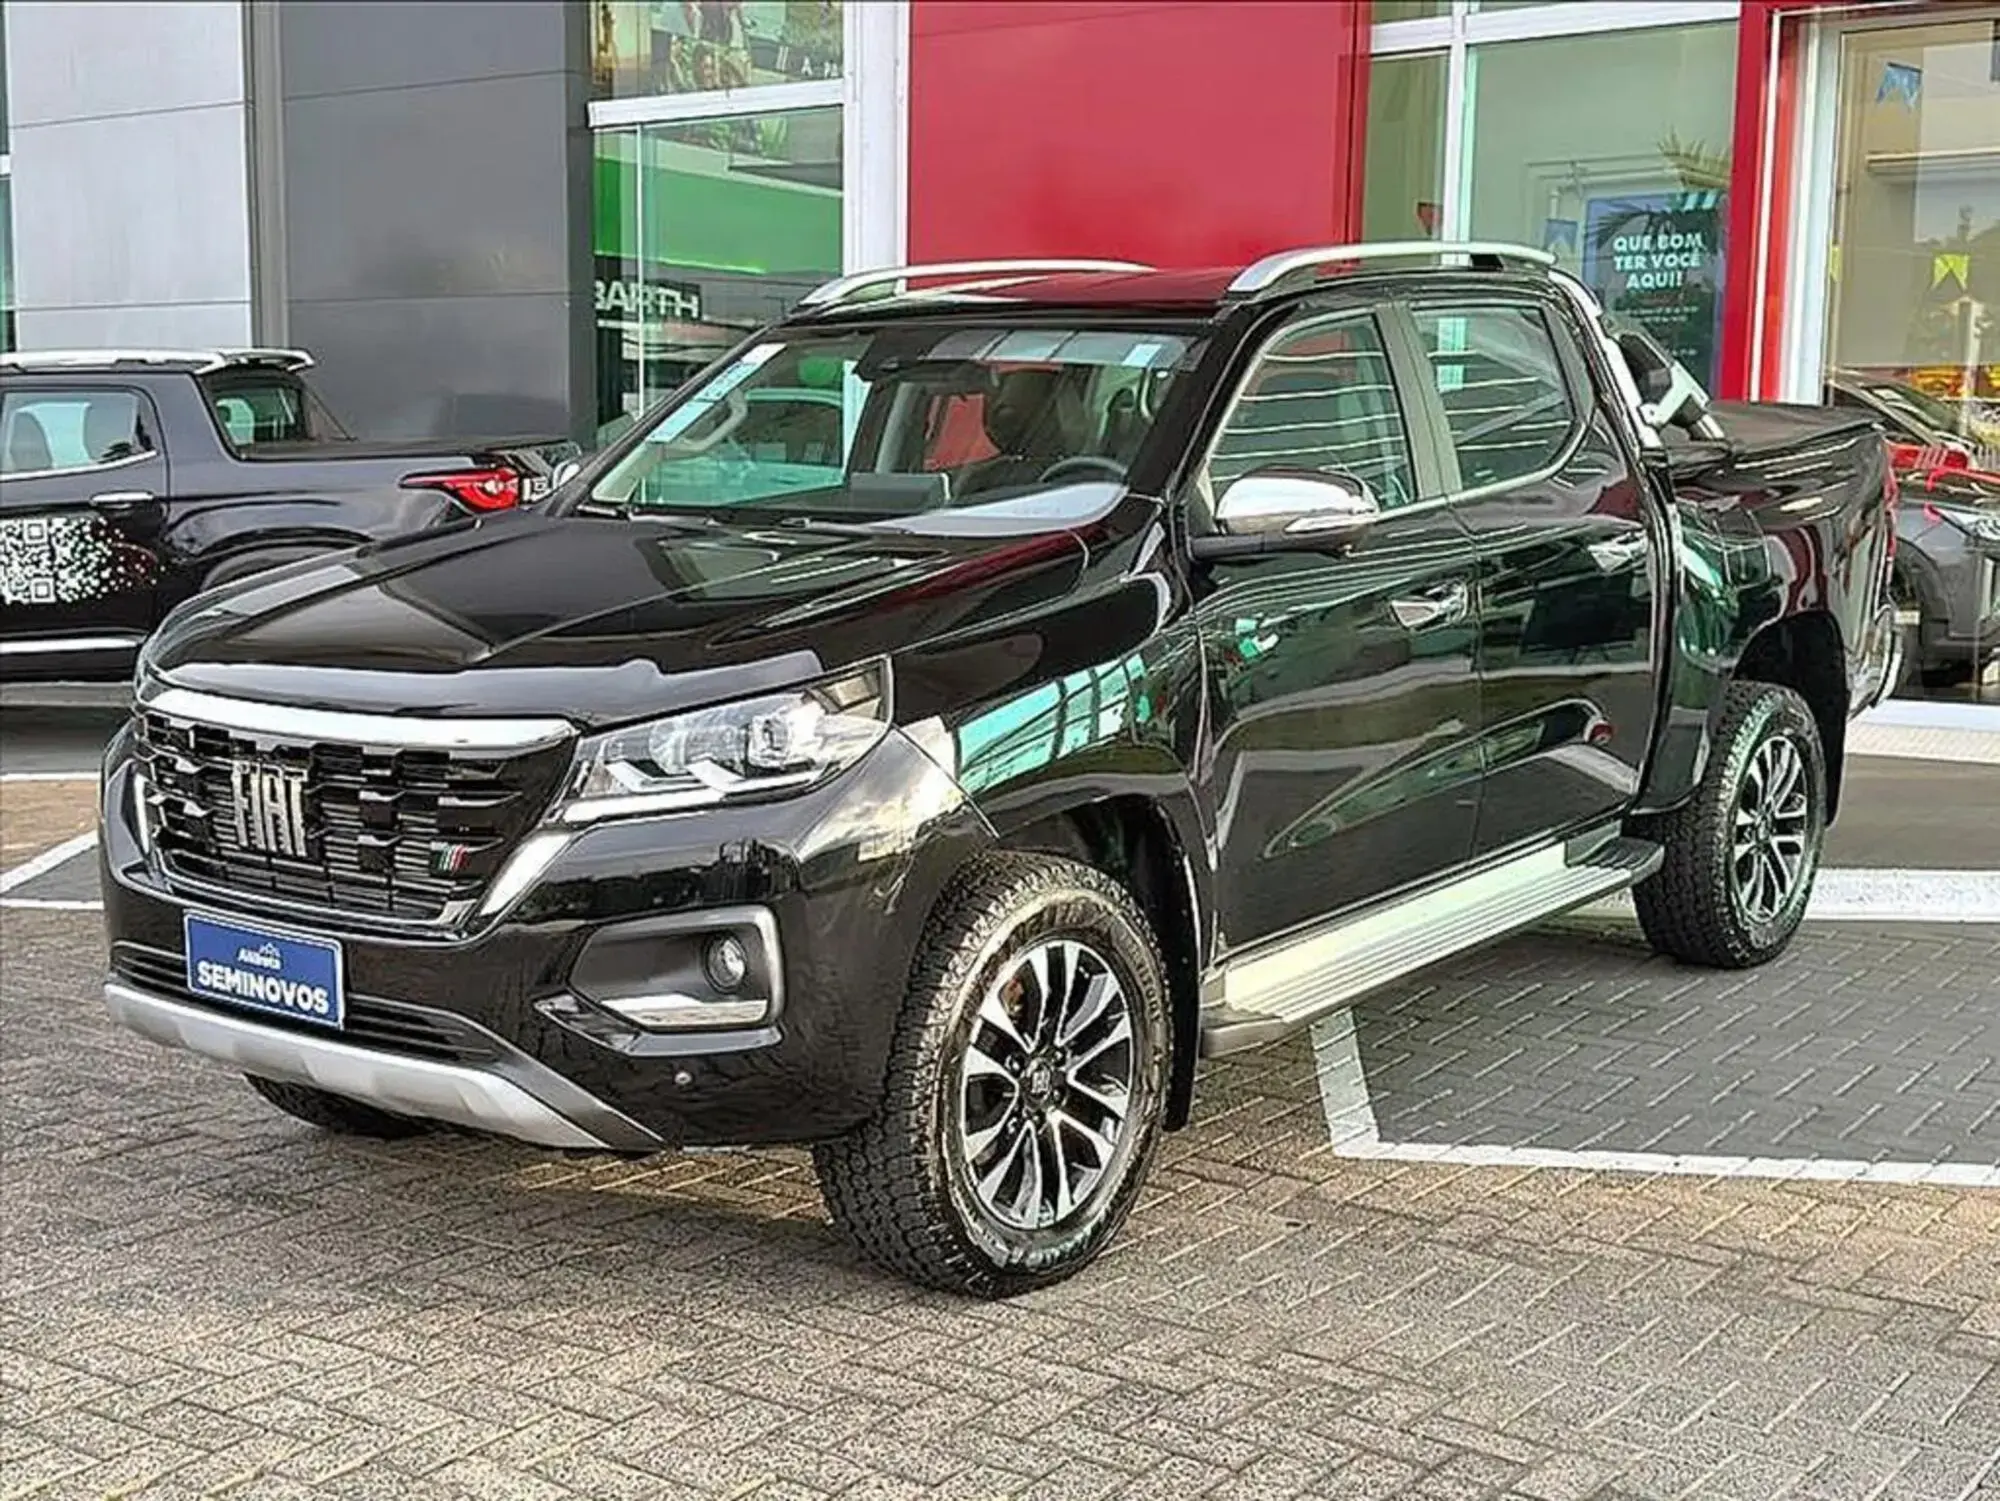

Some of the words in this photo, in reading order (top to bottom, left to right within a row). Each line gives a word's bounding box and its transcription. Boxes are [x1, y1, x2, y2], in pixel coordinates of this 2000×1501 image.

[1613, 235, 1652, 252] QUE
[1657, 233, 1705, 250] BOM
[1613, 255, 1647, 272] TER
[1626, 270, 1683, 290] AQUI!
[231, 760, 308, 857] FIAT
[197, 960, 330, 1015] SEMINOVOS
